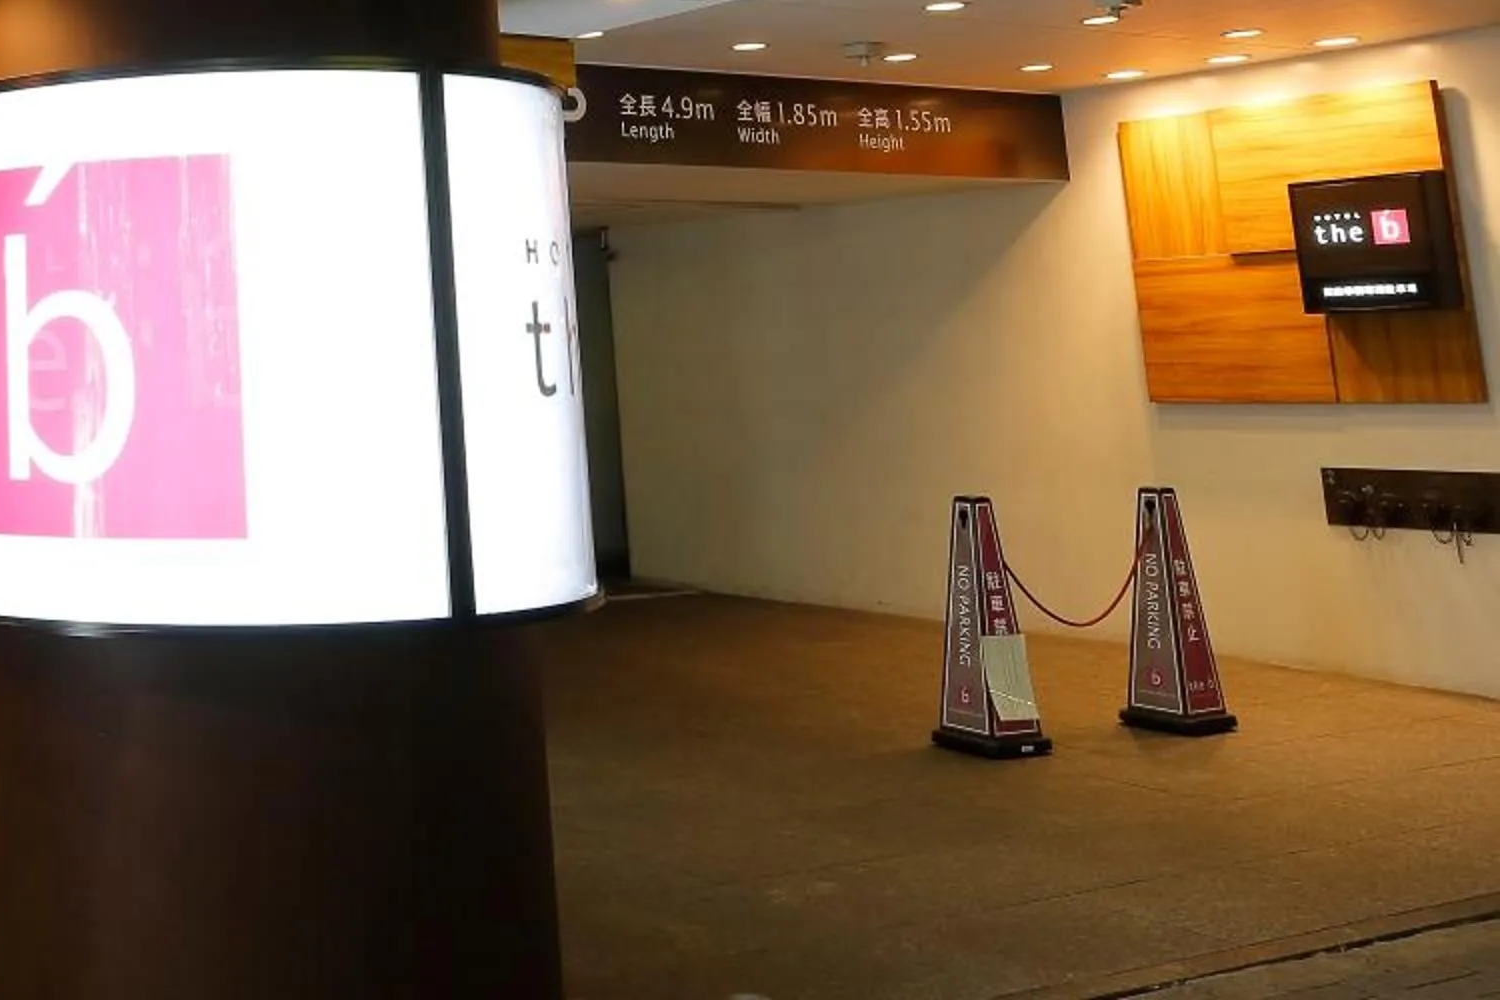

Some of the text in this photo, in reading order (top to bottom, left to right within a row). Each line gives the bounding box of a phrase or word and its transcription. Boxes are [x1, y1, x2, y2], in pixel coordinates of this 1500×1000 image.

[619, 93, 715, 121] 全長 4.9m
[737, 99, 838, 127] 全幅 1.85m
[857, 107, 951, 132] 全高 1.55m
[621, 121, 675, 143] Length
[737, 126, 781, 145] Width
[859, 133, 905, 153] Height
[1314, 223, 1364, 245] the
[1145, 553, 1161, 649] NO PARKING
[957, 565, 972, 666] NO PARKING
